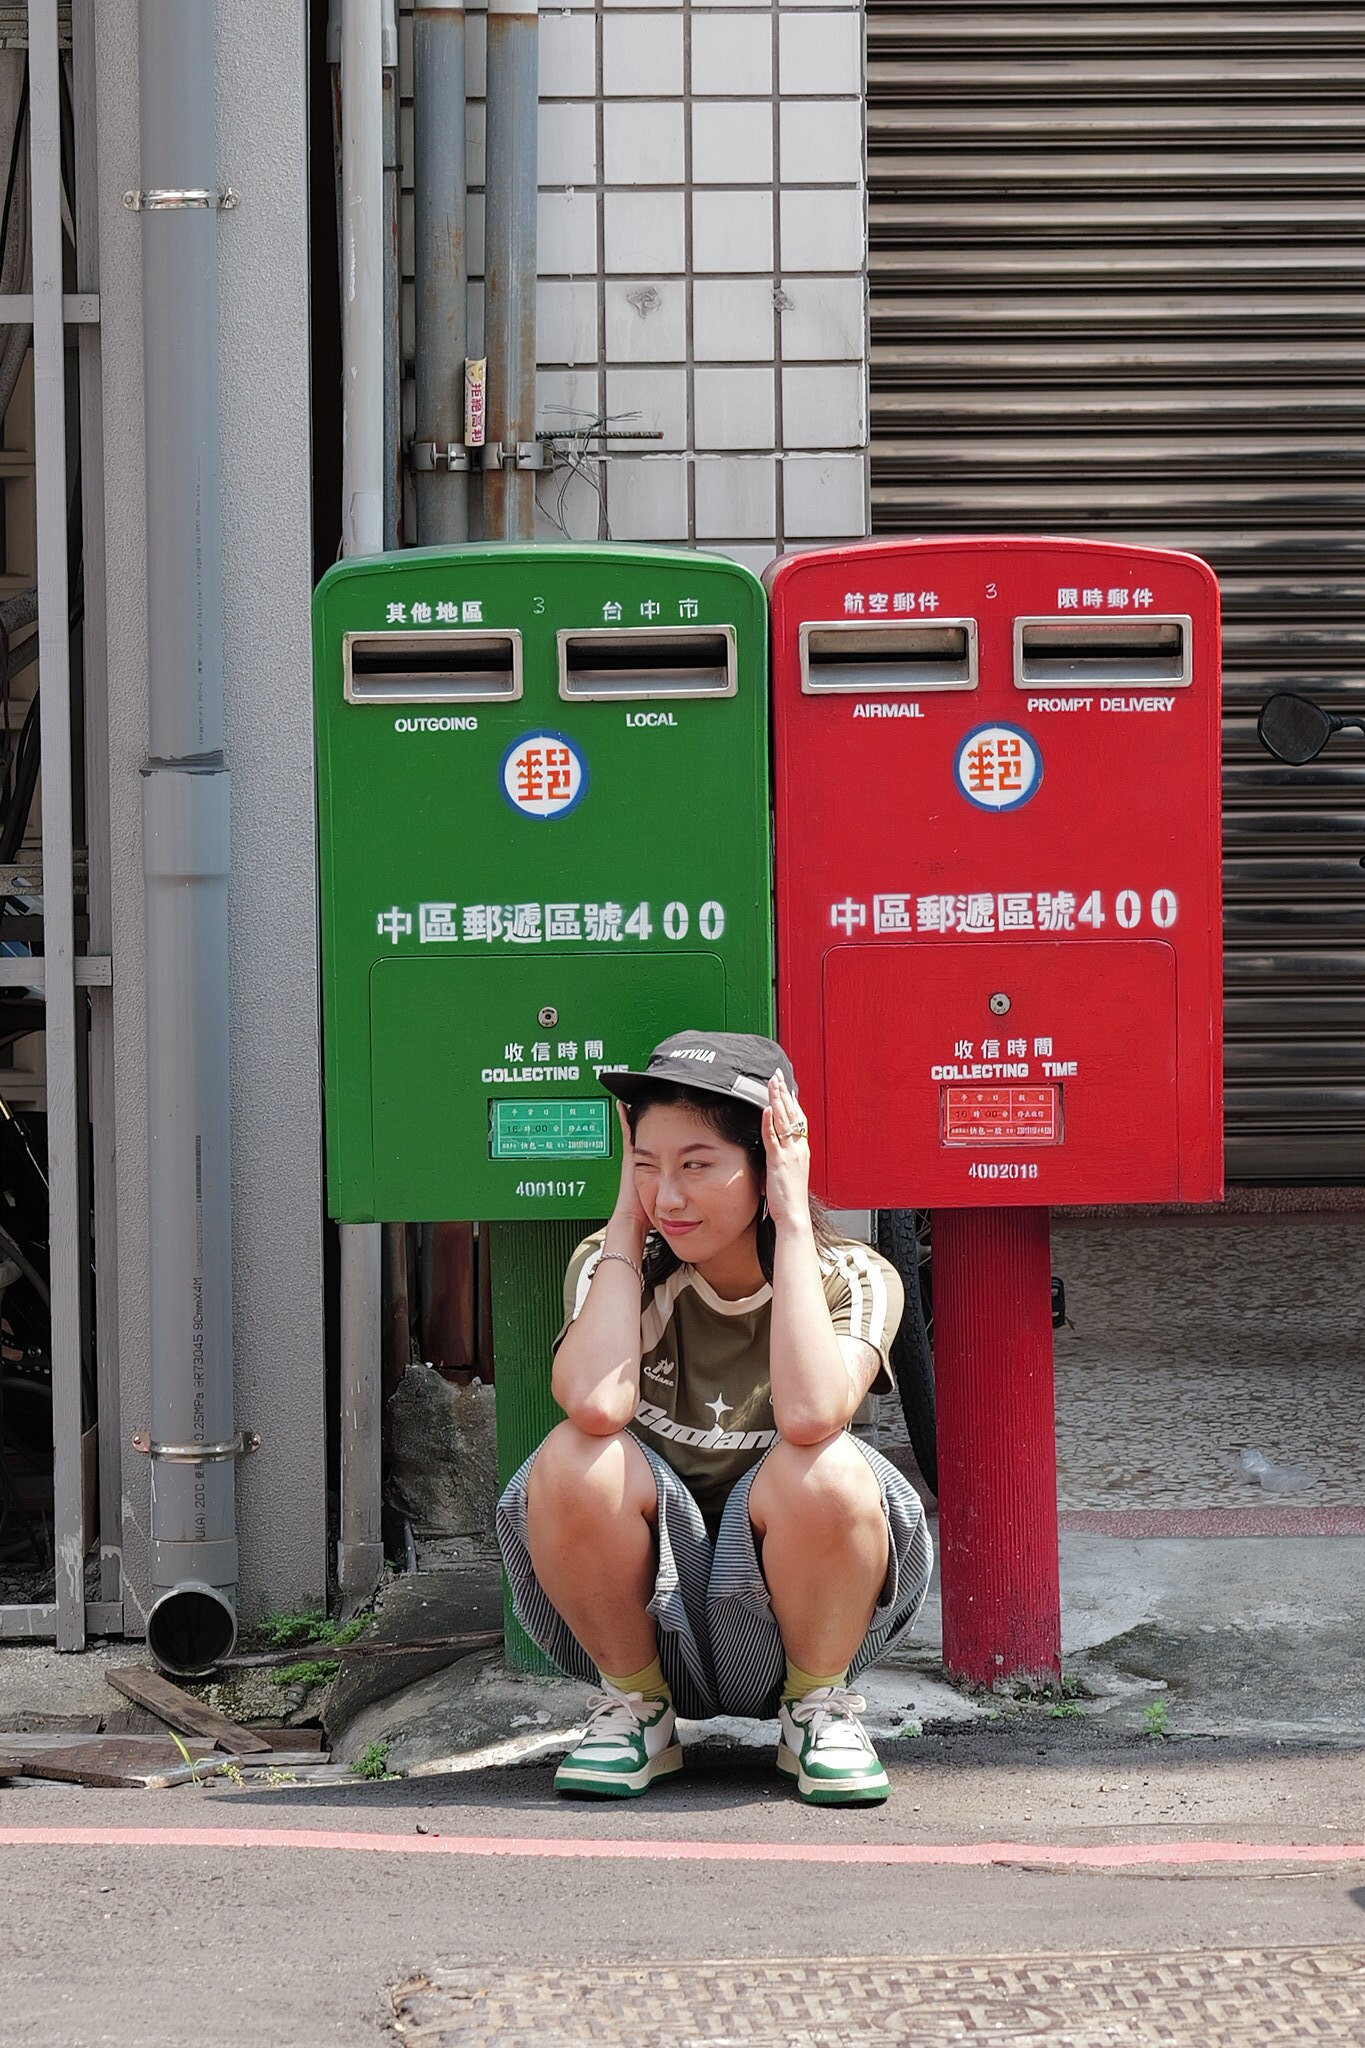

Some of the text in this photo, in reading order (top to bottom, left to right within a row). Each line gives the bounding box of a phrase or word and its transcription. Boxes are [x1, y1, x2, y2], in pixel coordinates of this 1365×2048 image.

[986, 583, 998, 599] 3
[1057, 588, 1154, 609] 限時郵件
[533, 597, 545, 615] 3
[602, 598, 699, 621] 台中市
[844, 592, 940, 614] 航空郵件
[386, 601, 483, 624] 其他地區
[853, 703, 925, 718] AIRMAIL
[1027, 697, 1176, 712] PROMPT DELIVERY
[394, 716, 478, 733] OUTGOING
[626, 712, 678, 727] LOCAL
[504, 1040, 604, 1063] 收信時間
[954, 1037, 1053, 1060] 收信時間
[481, 1066, 580, 1083] COLLECTING
[931, 1061, 1078, 1080] COLLECTING TIME
[968, 1162, 1038, 1179] 4002018
[515, 1180, 586, 1197] 4001017
